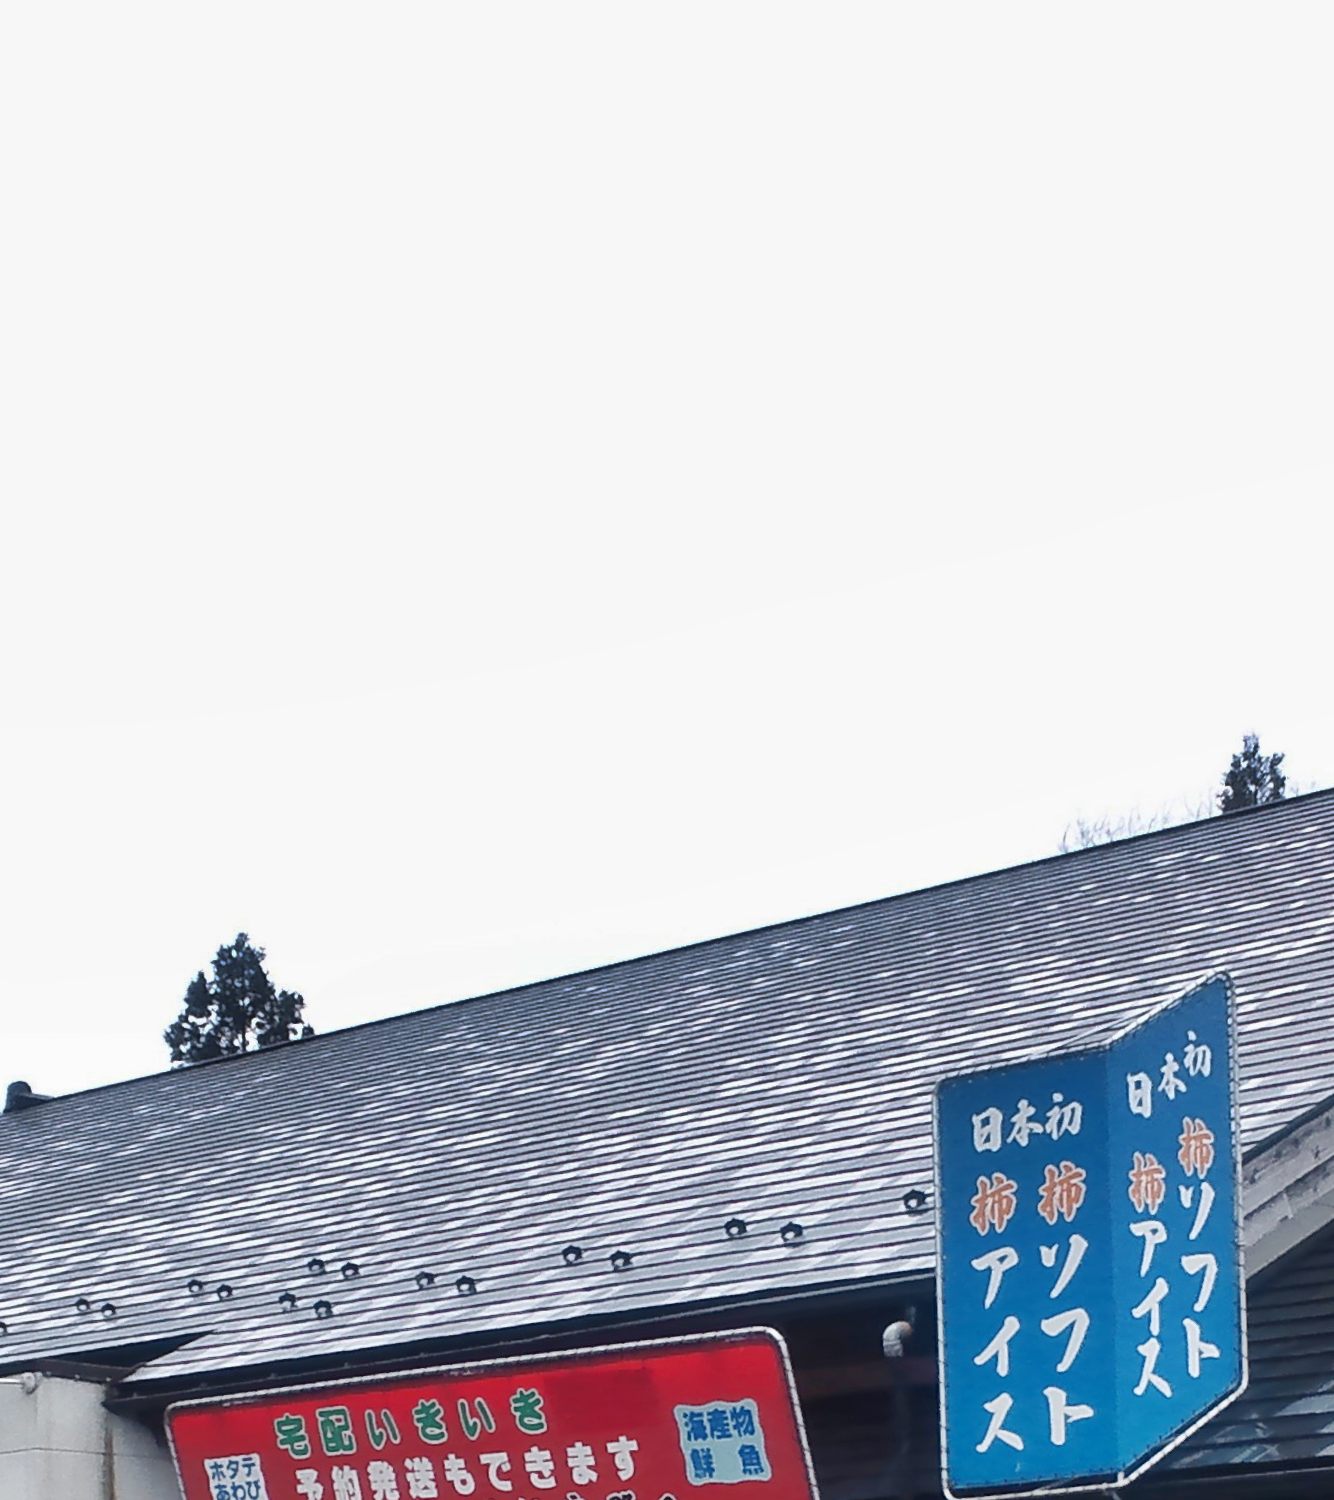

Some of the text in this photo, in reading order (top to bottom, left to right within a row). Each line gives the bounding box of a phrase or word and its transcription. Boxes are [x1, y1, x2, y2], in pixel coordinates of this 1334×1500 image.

[1126, 1030, 1212, 1119] 日本初
[971, 1092, 1083, 1153] 日本初
[1128, 1151, 1173, 1399] 柿アイス
[1177, 1116, 1221, 1378] 柿ソフト
[969, 1171, 1024, 1452] 柿アイス
[1037, 1160, 1094, 1445] 柿ソフト
[274, 1387, 548, 1459] 宅配いきいき
[682, 1405, 756, 1442] 海産物
[209, 1457, 257, 1480] ホタテ
